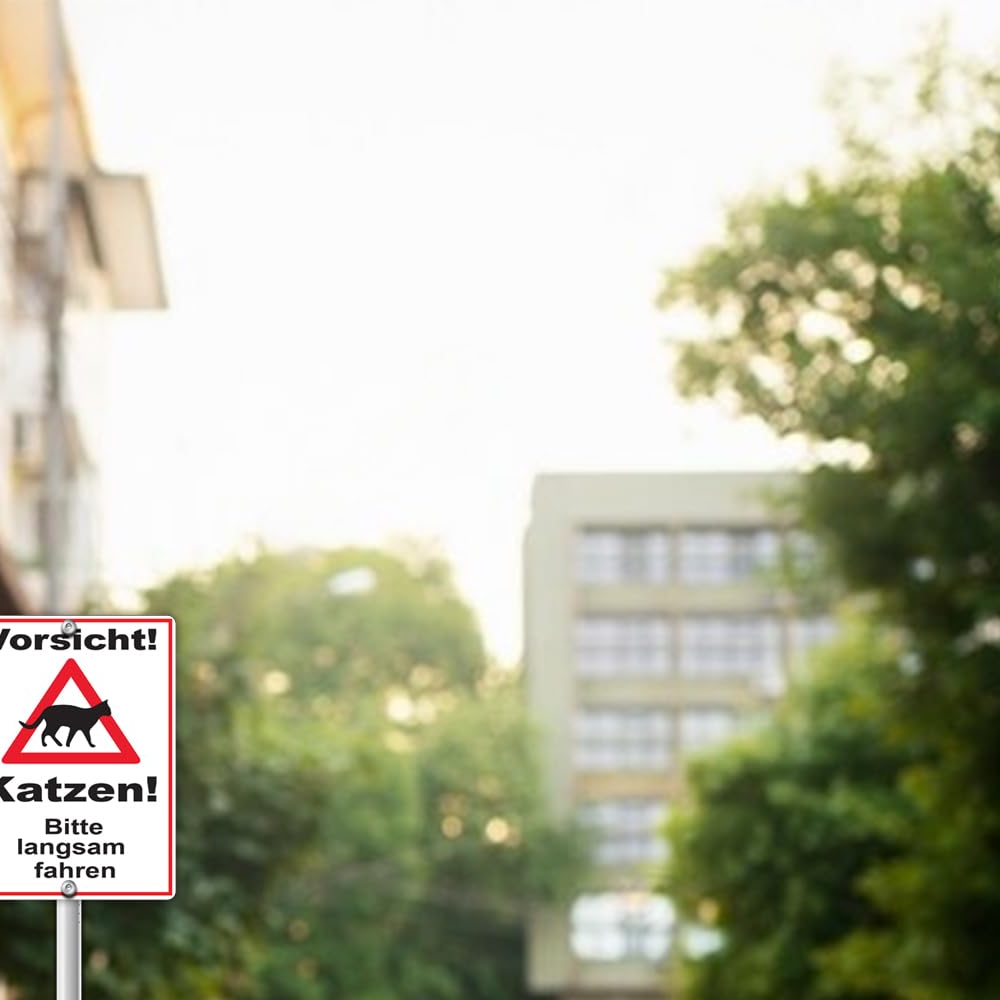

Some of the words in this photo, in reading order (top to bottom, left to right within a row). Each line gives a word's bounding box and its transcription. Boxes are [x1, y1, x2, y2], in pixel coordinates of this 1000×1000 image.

[45, 818, 103, 835] Bitte
[17, 838, 125, 860] langsam
[33, 861, 116, 879] fahren
